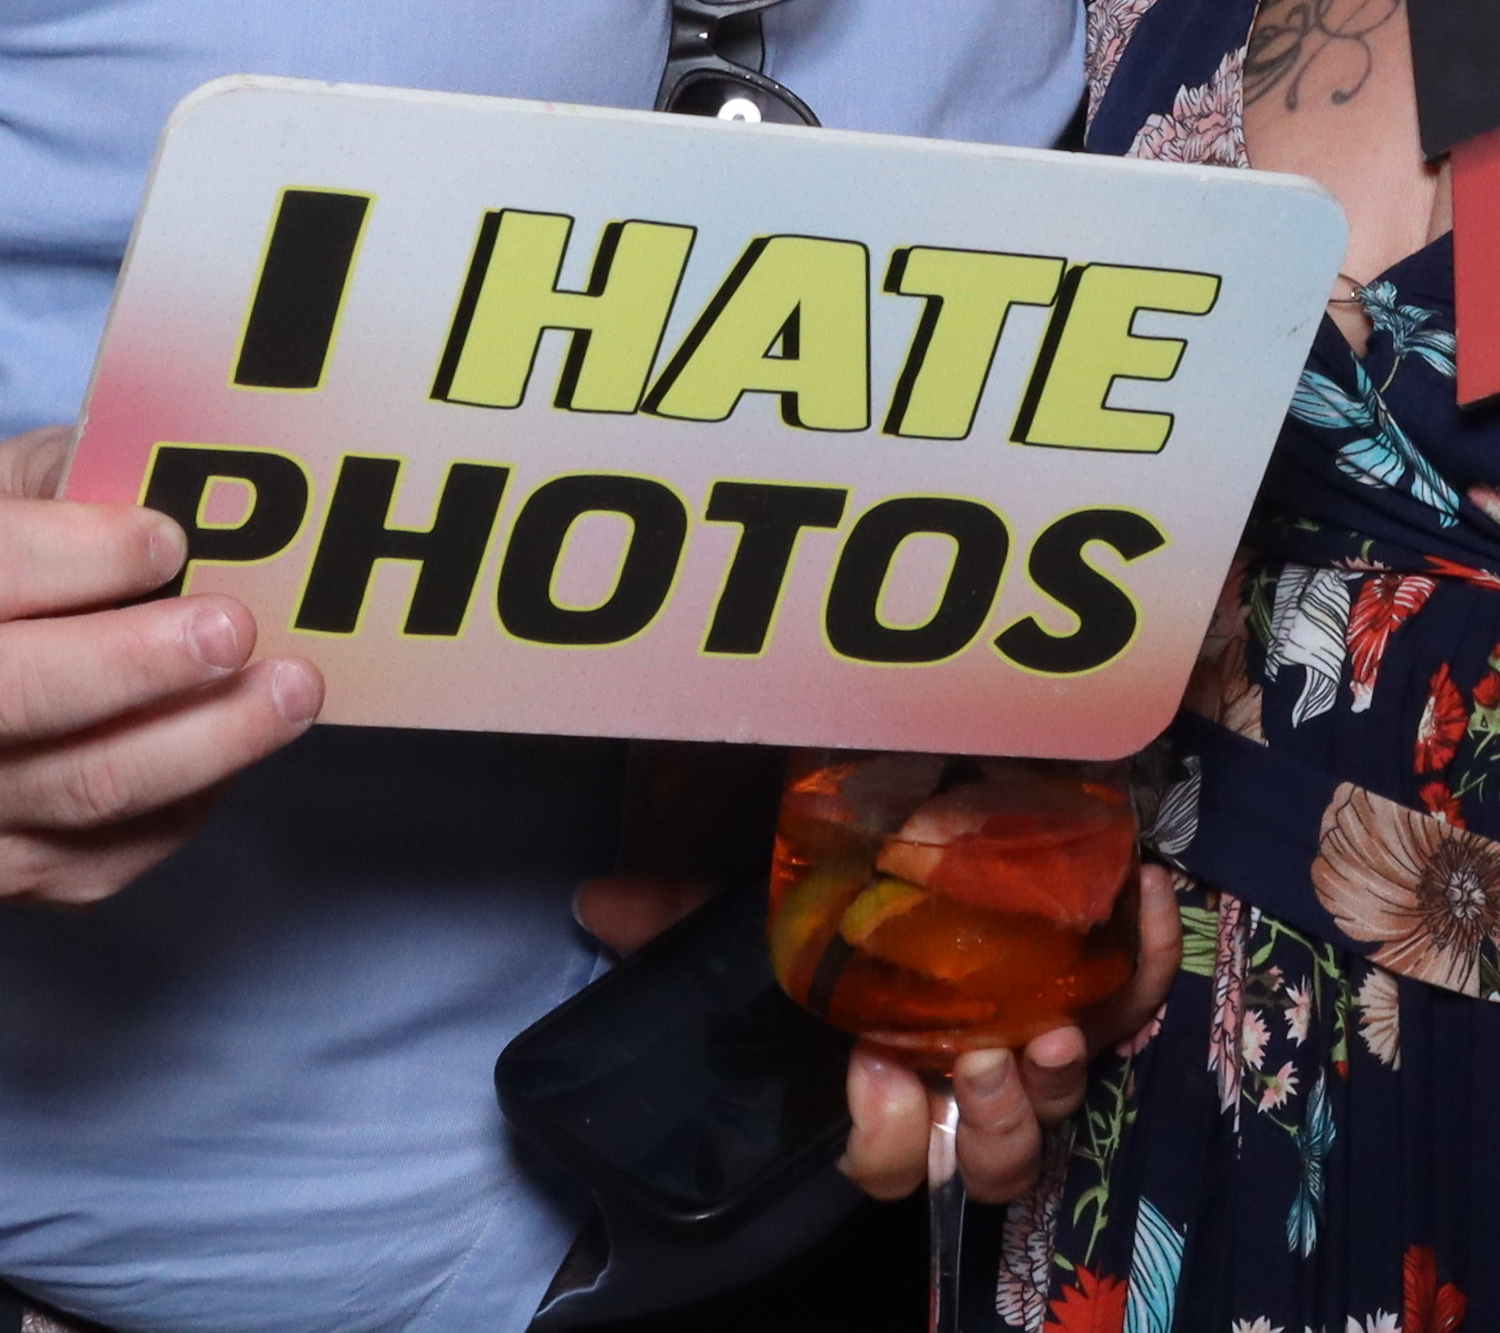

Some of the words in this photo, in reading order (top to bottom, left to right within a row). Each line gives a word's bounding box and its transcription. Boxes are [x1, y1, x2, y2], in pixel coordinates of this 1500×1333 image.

[227, 185, 377, 395] I
[426, 207, 1222, 454] HATE
[140, 441, 1174, 679] PHOTOS
